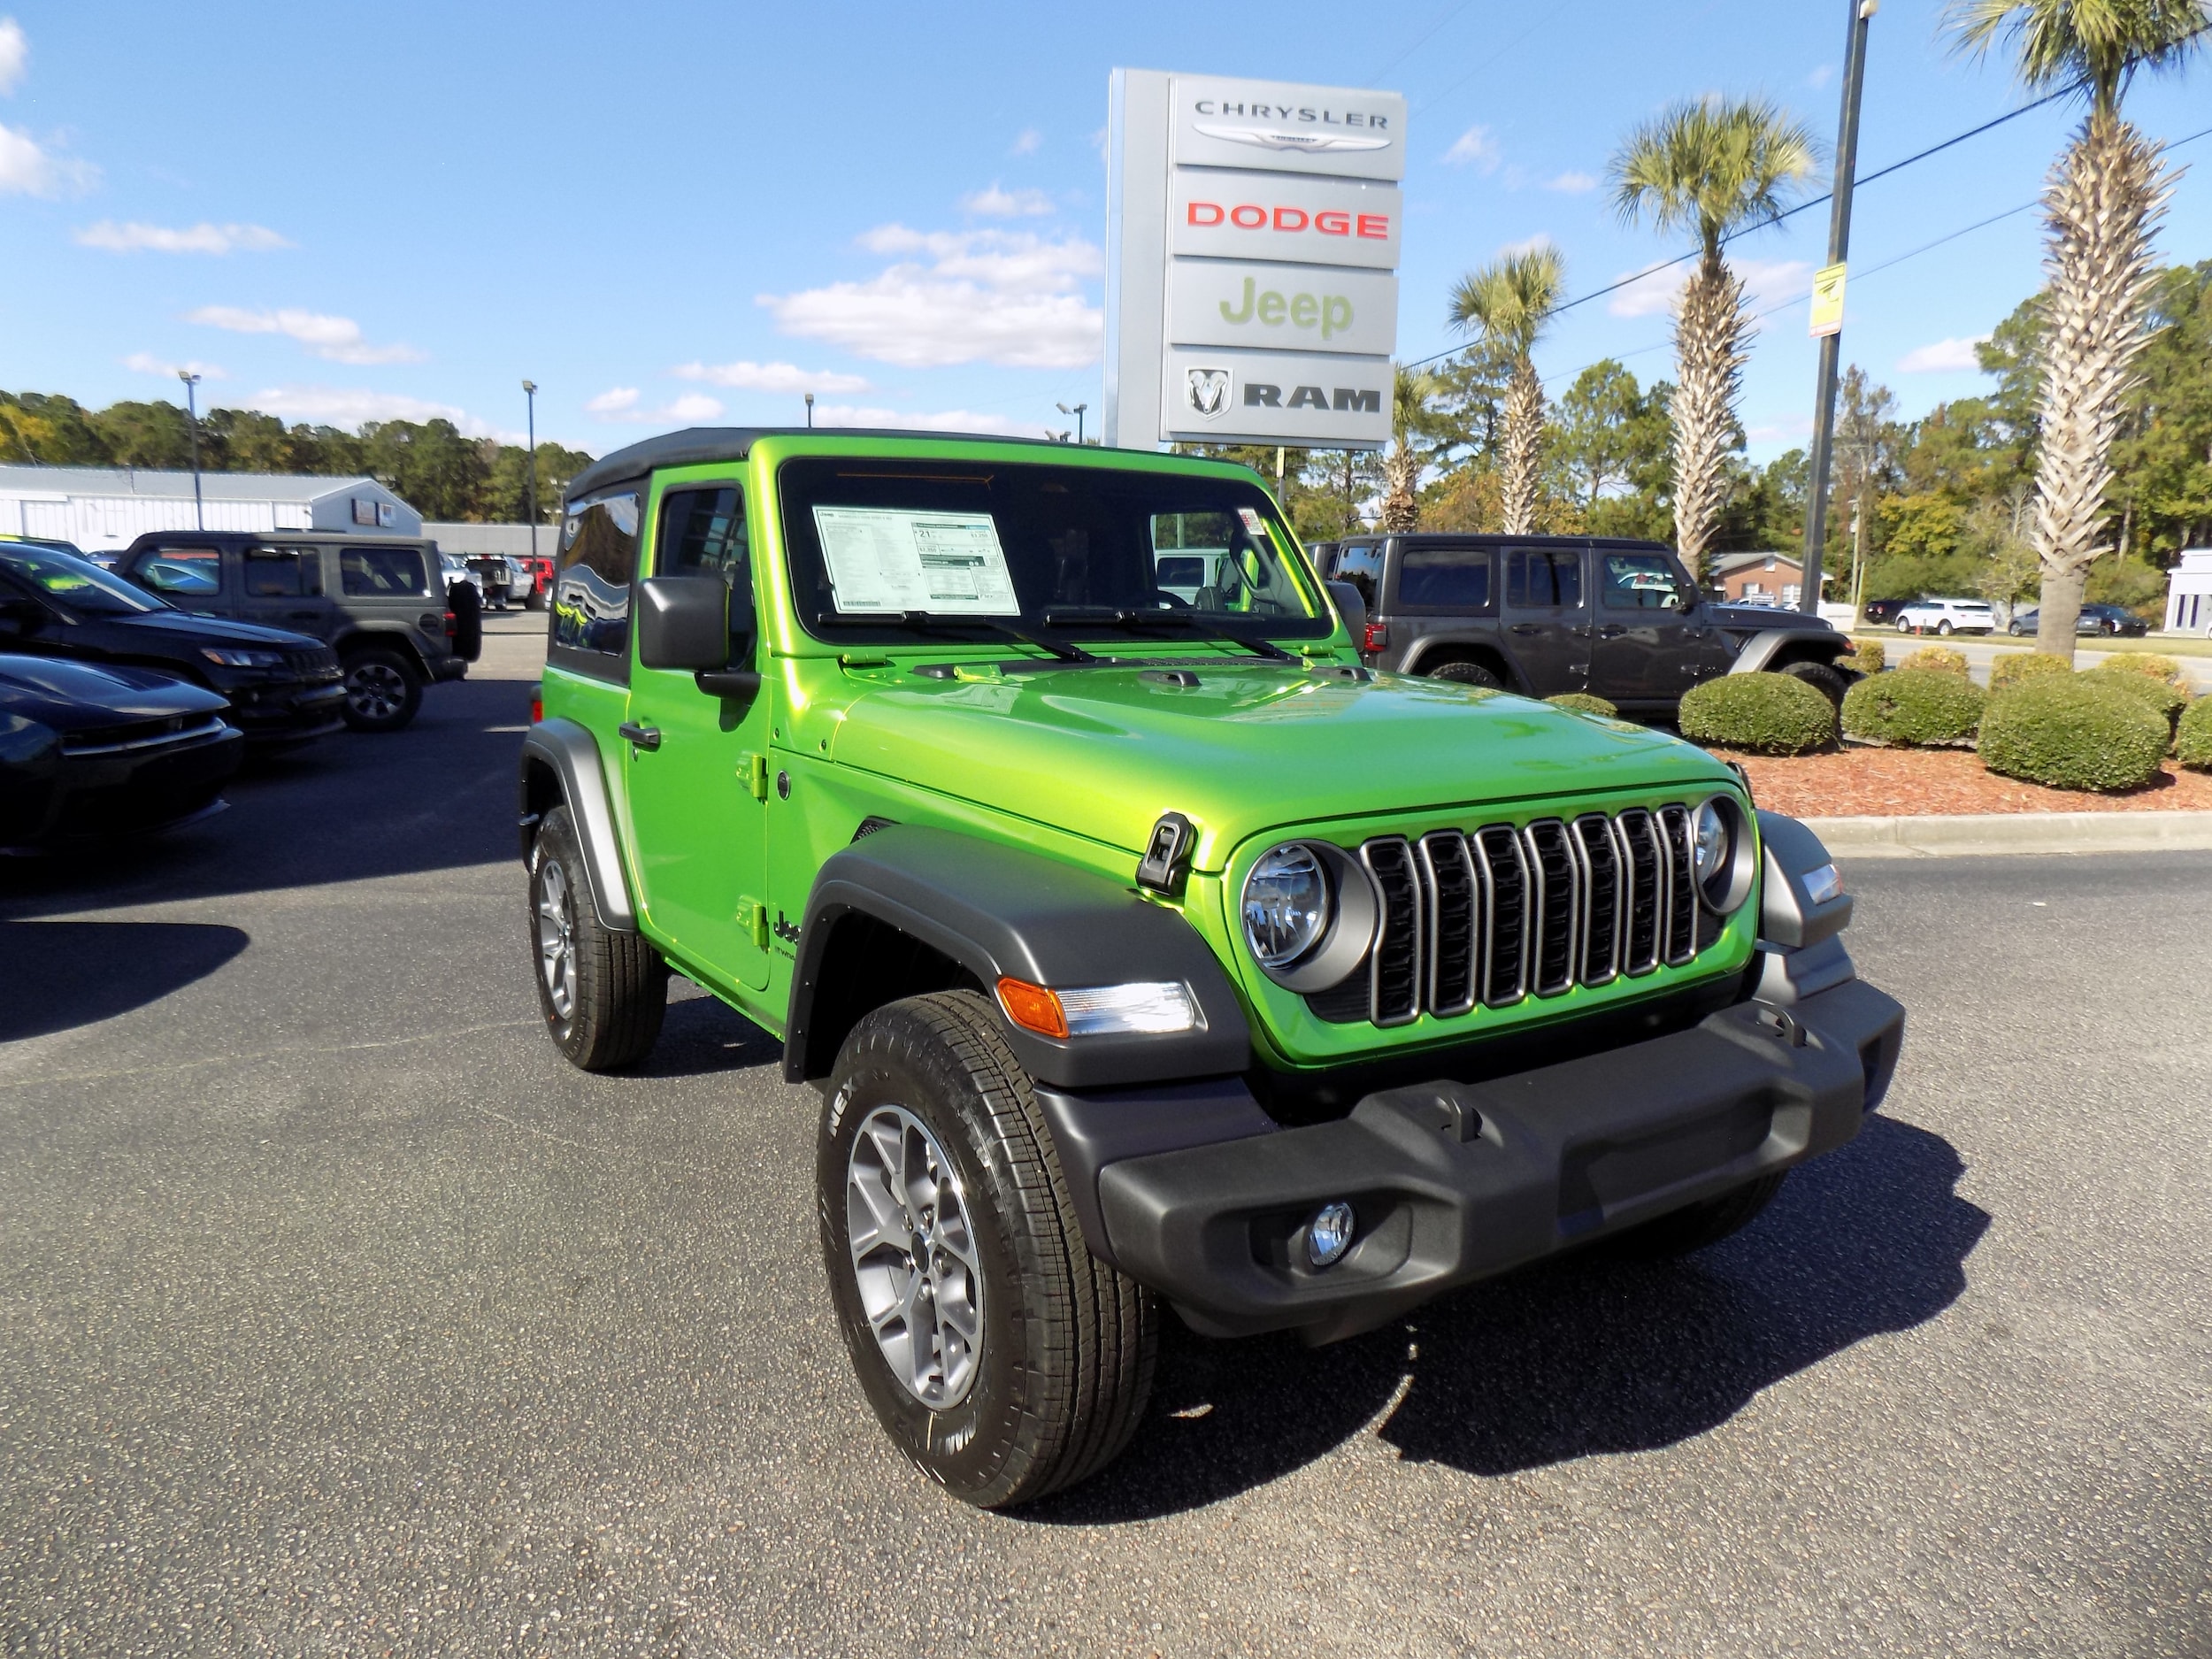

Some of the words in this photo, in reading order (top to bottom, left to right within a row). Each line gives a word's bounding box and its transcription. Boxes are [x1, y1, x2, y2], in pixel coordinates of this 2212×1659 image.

[1194, 102, 1388, 129] CHRYSLER
[1187, 203, 1388, 240] DODGE
[1218, 276, 1354, 340] Jeep
[1243, 382, 1380, 413] RAM
[773, 910, 802, 947] Jee
